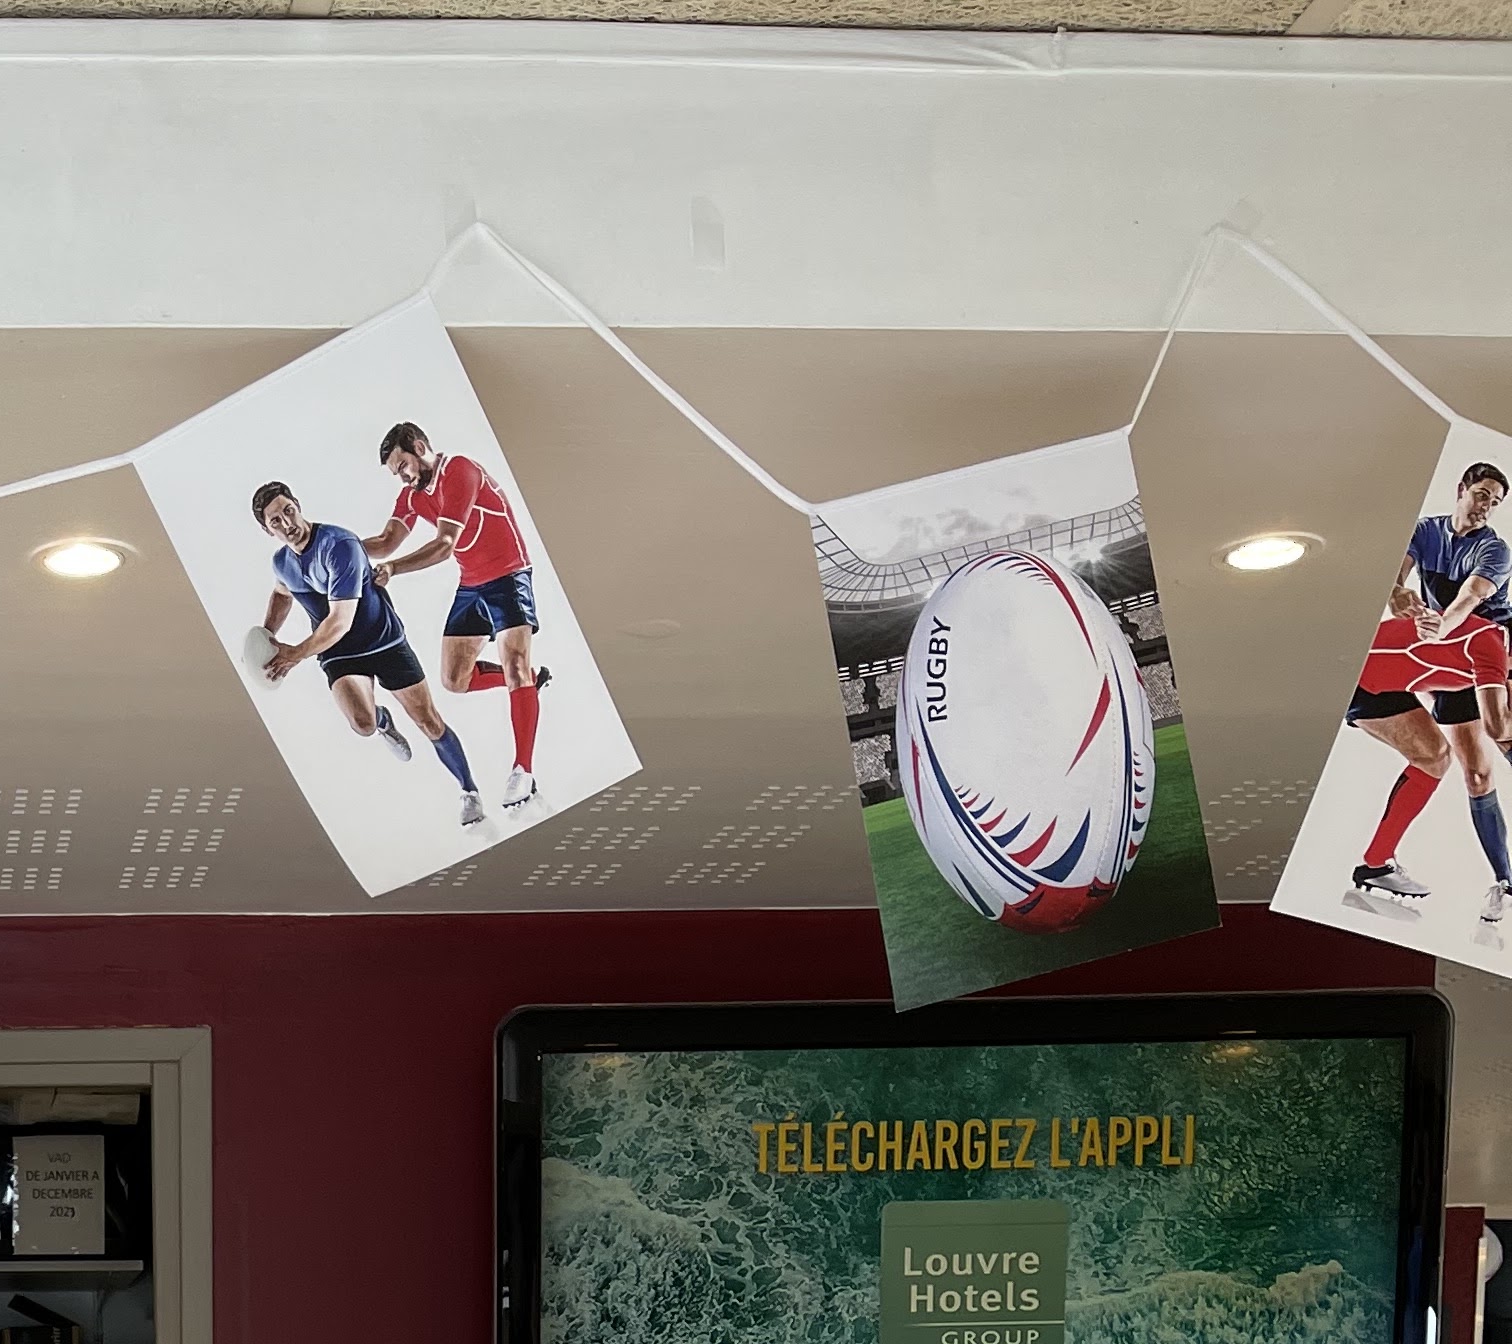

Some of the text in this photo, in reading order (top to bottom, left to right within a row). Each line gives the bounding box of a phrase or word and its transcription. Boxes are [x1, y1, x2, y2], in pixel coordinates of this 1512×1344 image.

[928, 615, 952, 722] RUGBY
[48, 1152, 71, 1163] VAD
[752, 1111, 1196, 1173] TÉLÉCHARGEZ L'APPLI
[26, 1170, 99, 1181] DE JANVIER A
[33, 1189, 93, 1199] DECEMBRE
[904, 1246, 1040, 1277] Louvre
[909, 1281, 1040, 1313] Hotels
